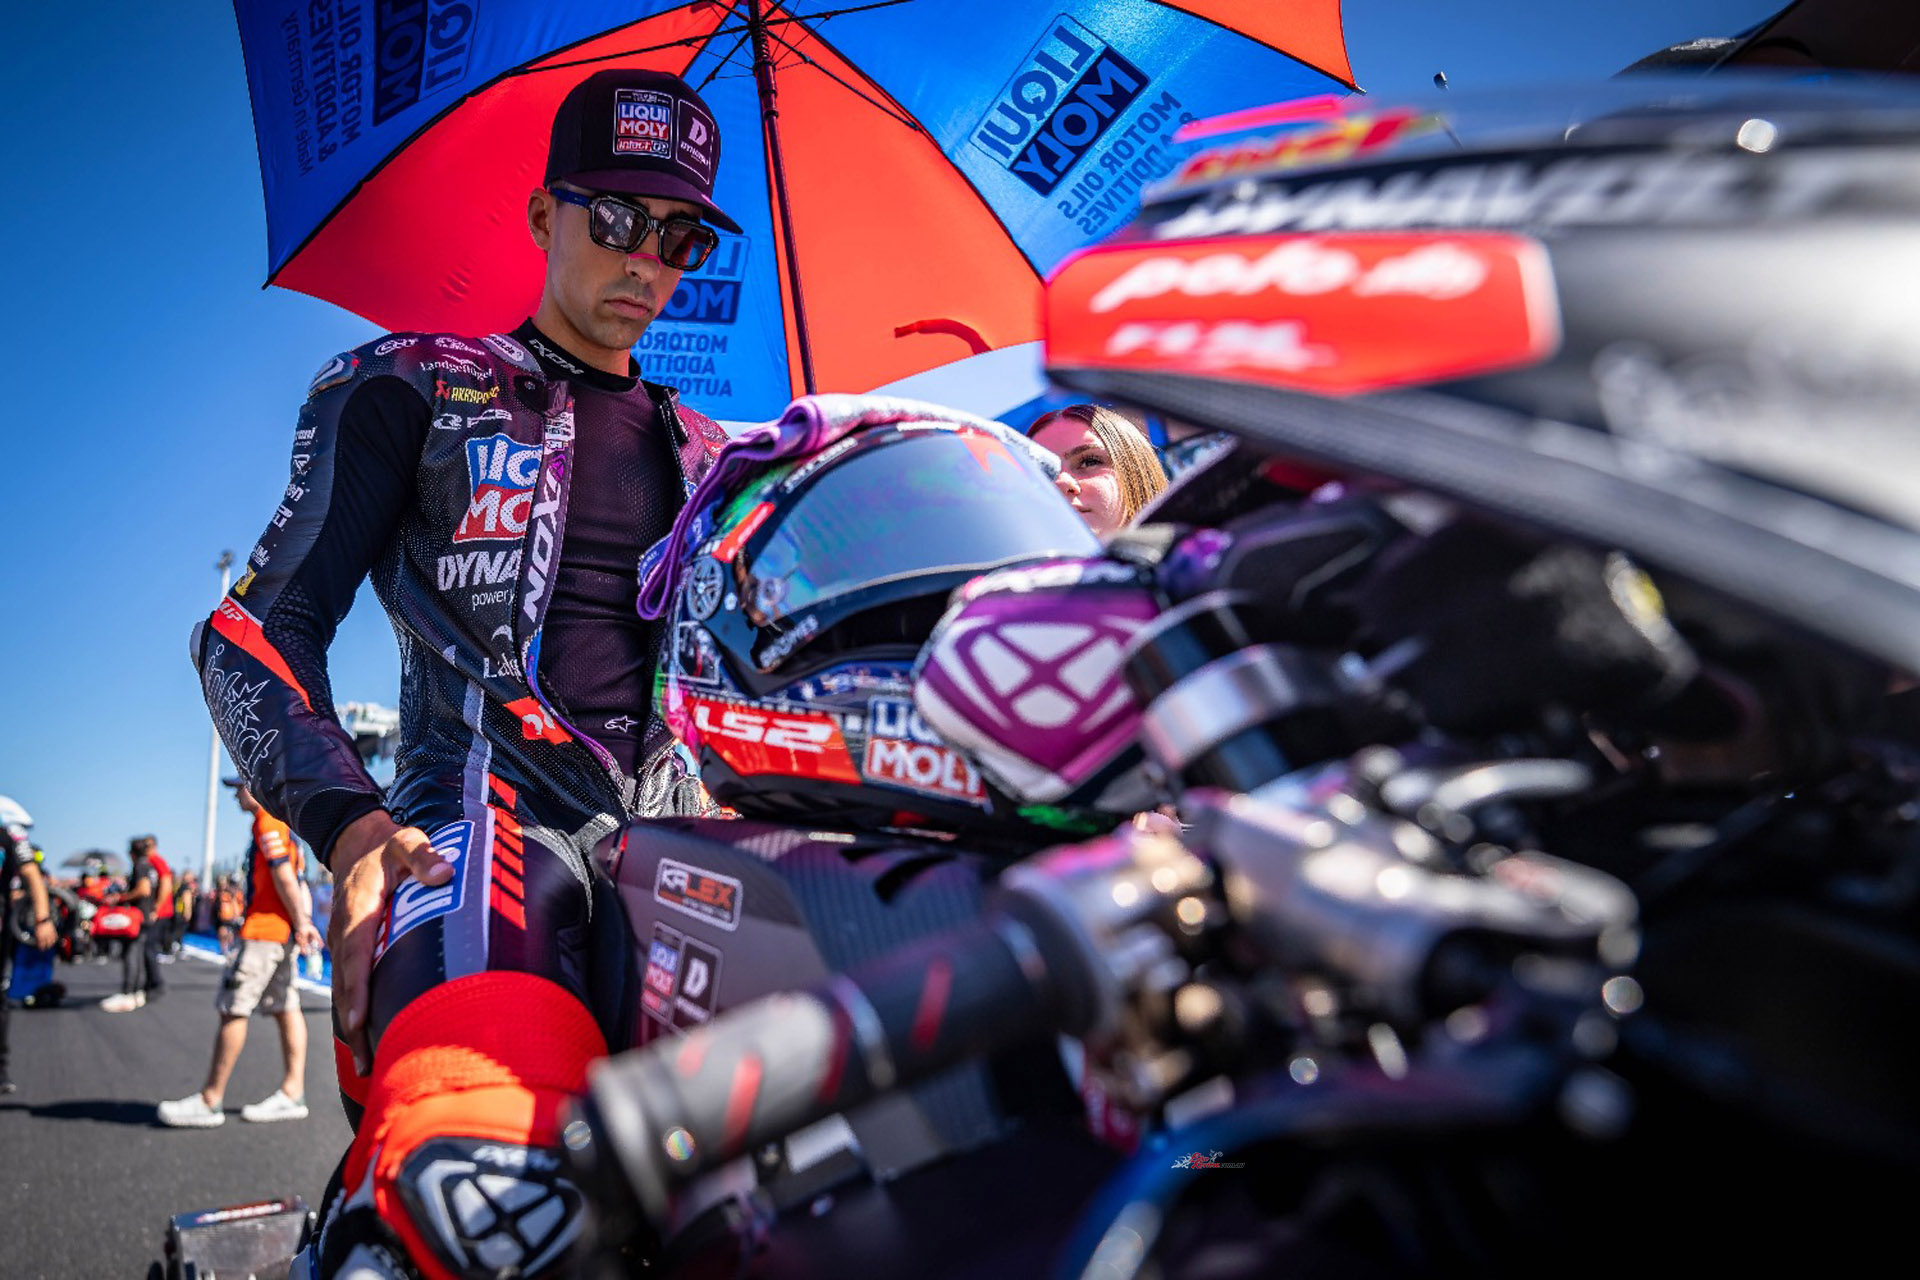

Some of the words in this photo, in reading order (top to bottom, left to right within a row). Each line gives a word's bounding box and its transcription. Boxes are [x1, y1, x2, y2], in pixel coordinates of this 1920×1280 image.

[621, 105, 667, 122] LIQUI
[620, 120, 668, 138] MOLY
[695, 704, 834, 753] LS2
